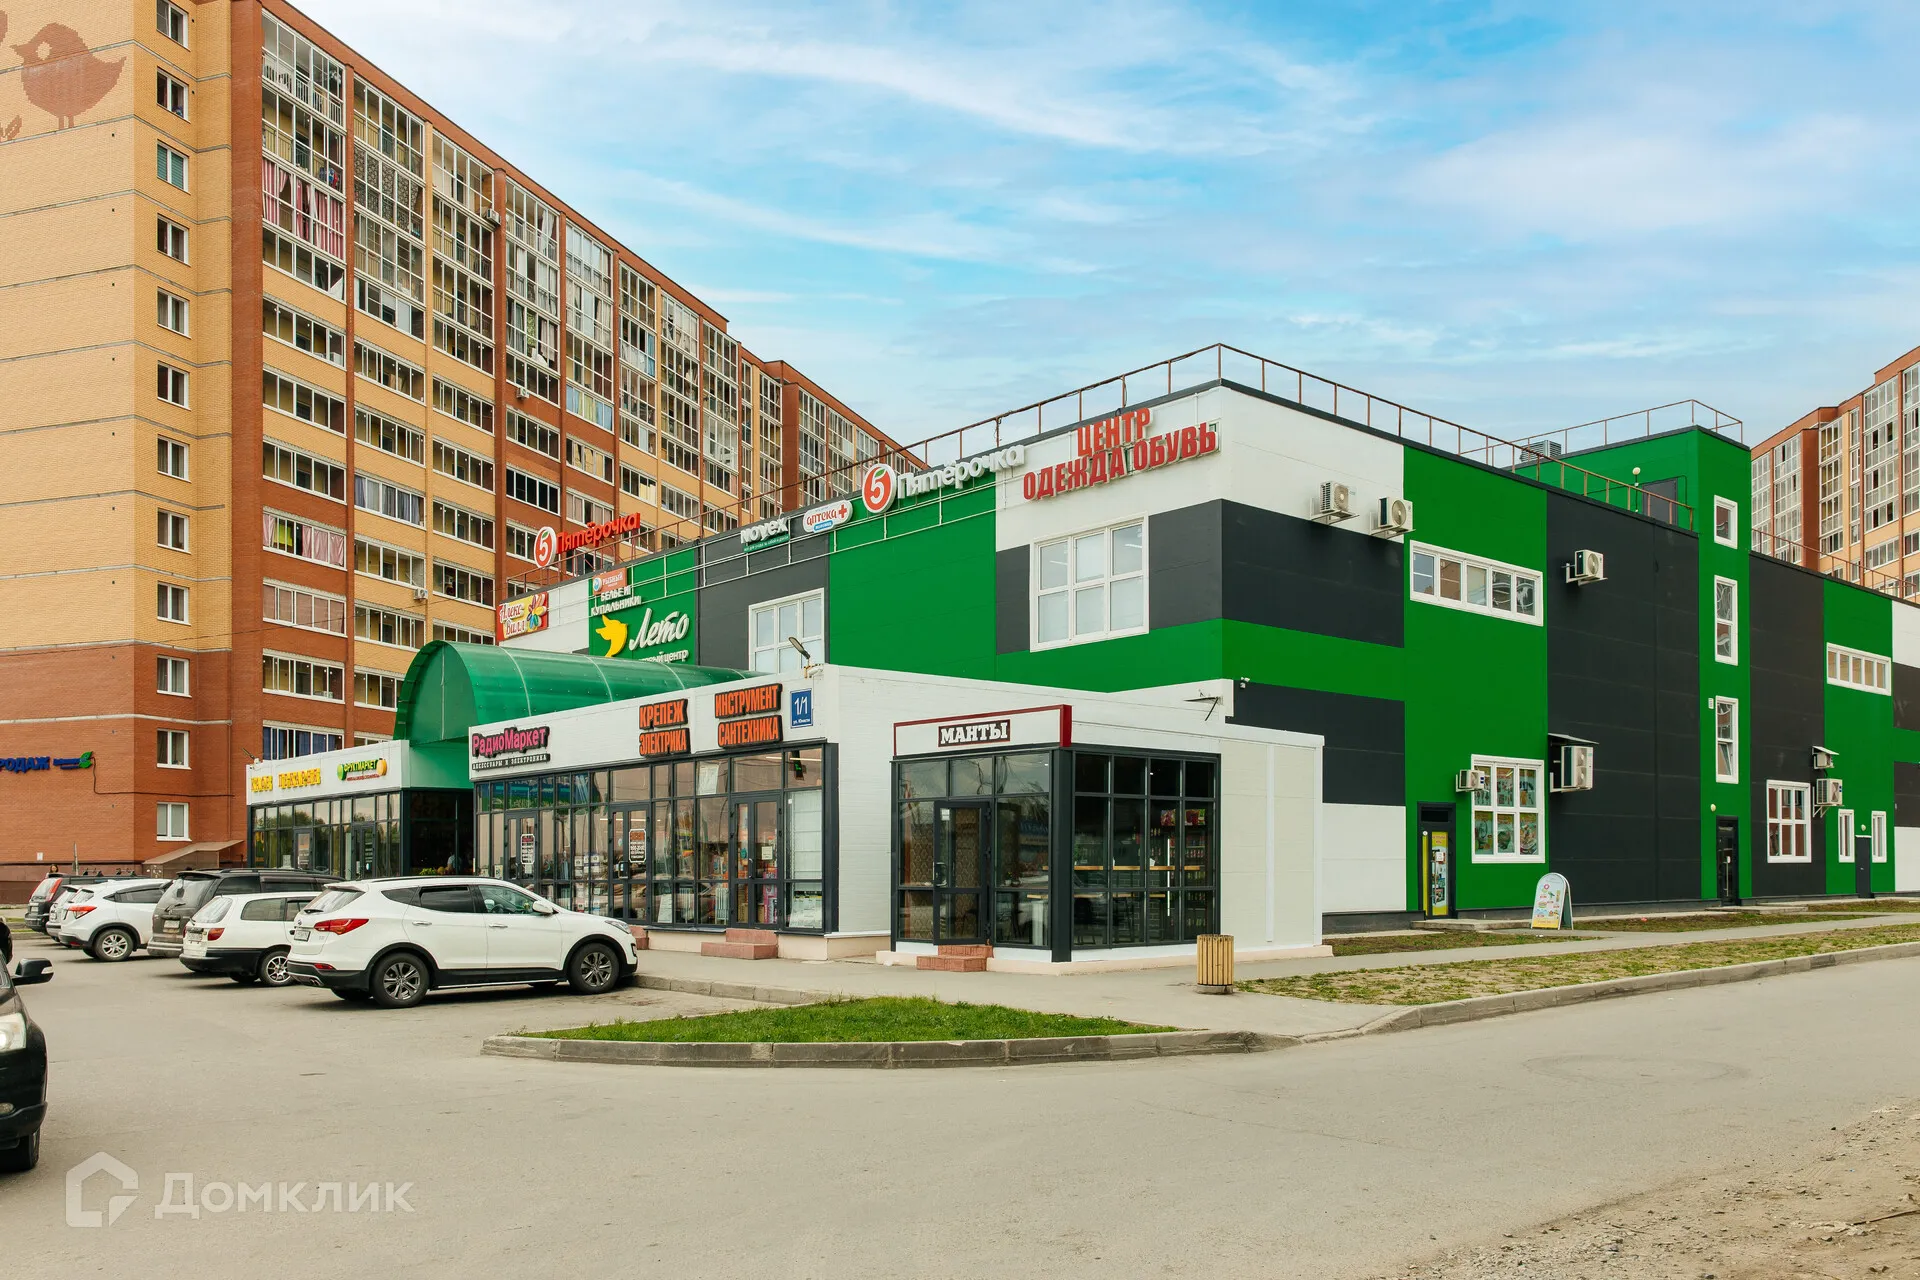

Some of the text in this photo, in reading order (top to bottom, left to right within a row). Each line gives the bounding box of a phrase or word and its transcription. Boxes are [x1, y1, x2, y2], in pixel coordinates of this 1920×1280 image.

[1077, 407, 1151, 457] ЦЕНТР
[1023, 422, 1217, 500] ОДЕЖДА ОБУВЬ
[806, 509, 837, 526] аптека
[556, 512, 641, 555] Пятёрочка
[590, 596, 642, 617] КУПАЛЬНИКИ
[628, 607, 690, 651] Лето
[664, 649, 689, 663] центр
[640, 700, 685, 728] КРЕПЕЖ
[715, 684, 779, 717] ИНСТРУМЕНТ
[794, 696, 808, 716] 1/1
[472, 727, 547, 757] РадиоМаркет
[640, 729, 687, 755] ЭЛЕКТРИКА
[719, 716, 780, 747] САНТЕХНИКА
[940, 722, 1008, 745] МАНТЫ
